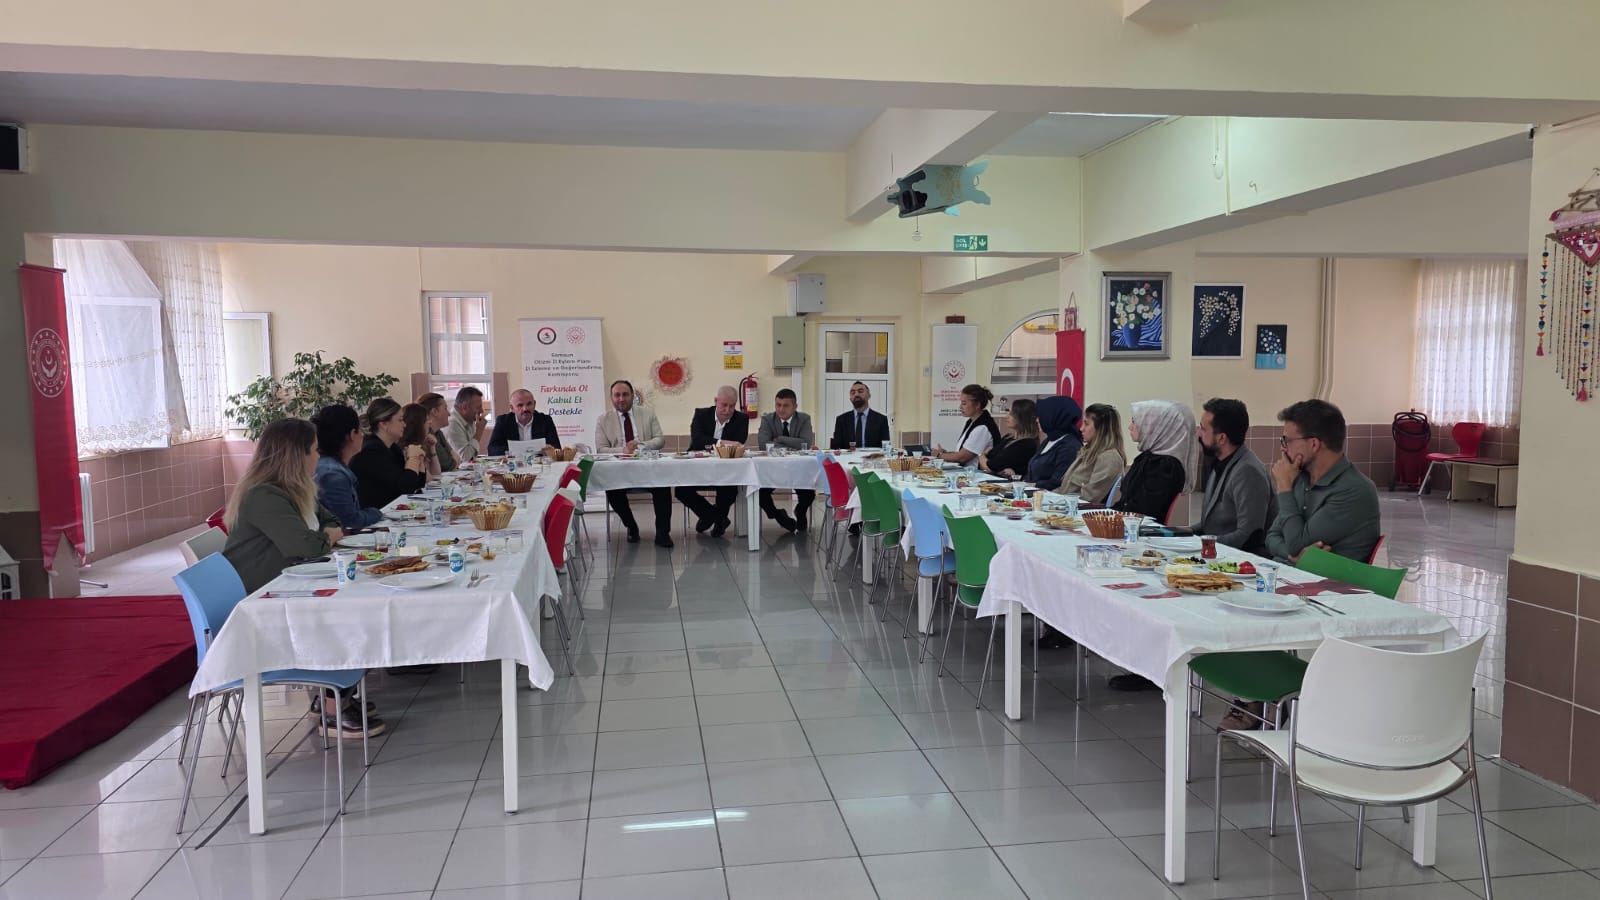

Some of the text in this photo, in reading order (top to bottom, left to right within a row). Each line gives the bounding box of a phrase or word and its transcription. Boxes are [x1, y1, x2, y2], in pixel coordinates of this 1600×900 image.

[540, 384, 589, 393] Farkında Ol
[547, 395, 582, 405] Kabul Et
[548, 407, 583, 416] Destekle
